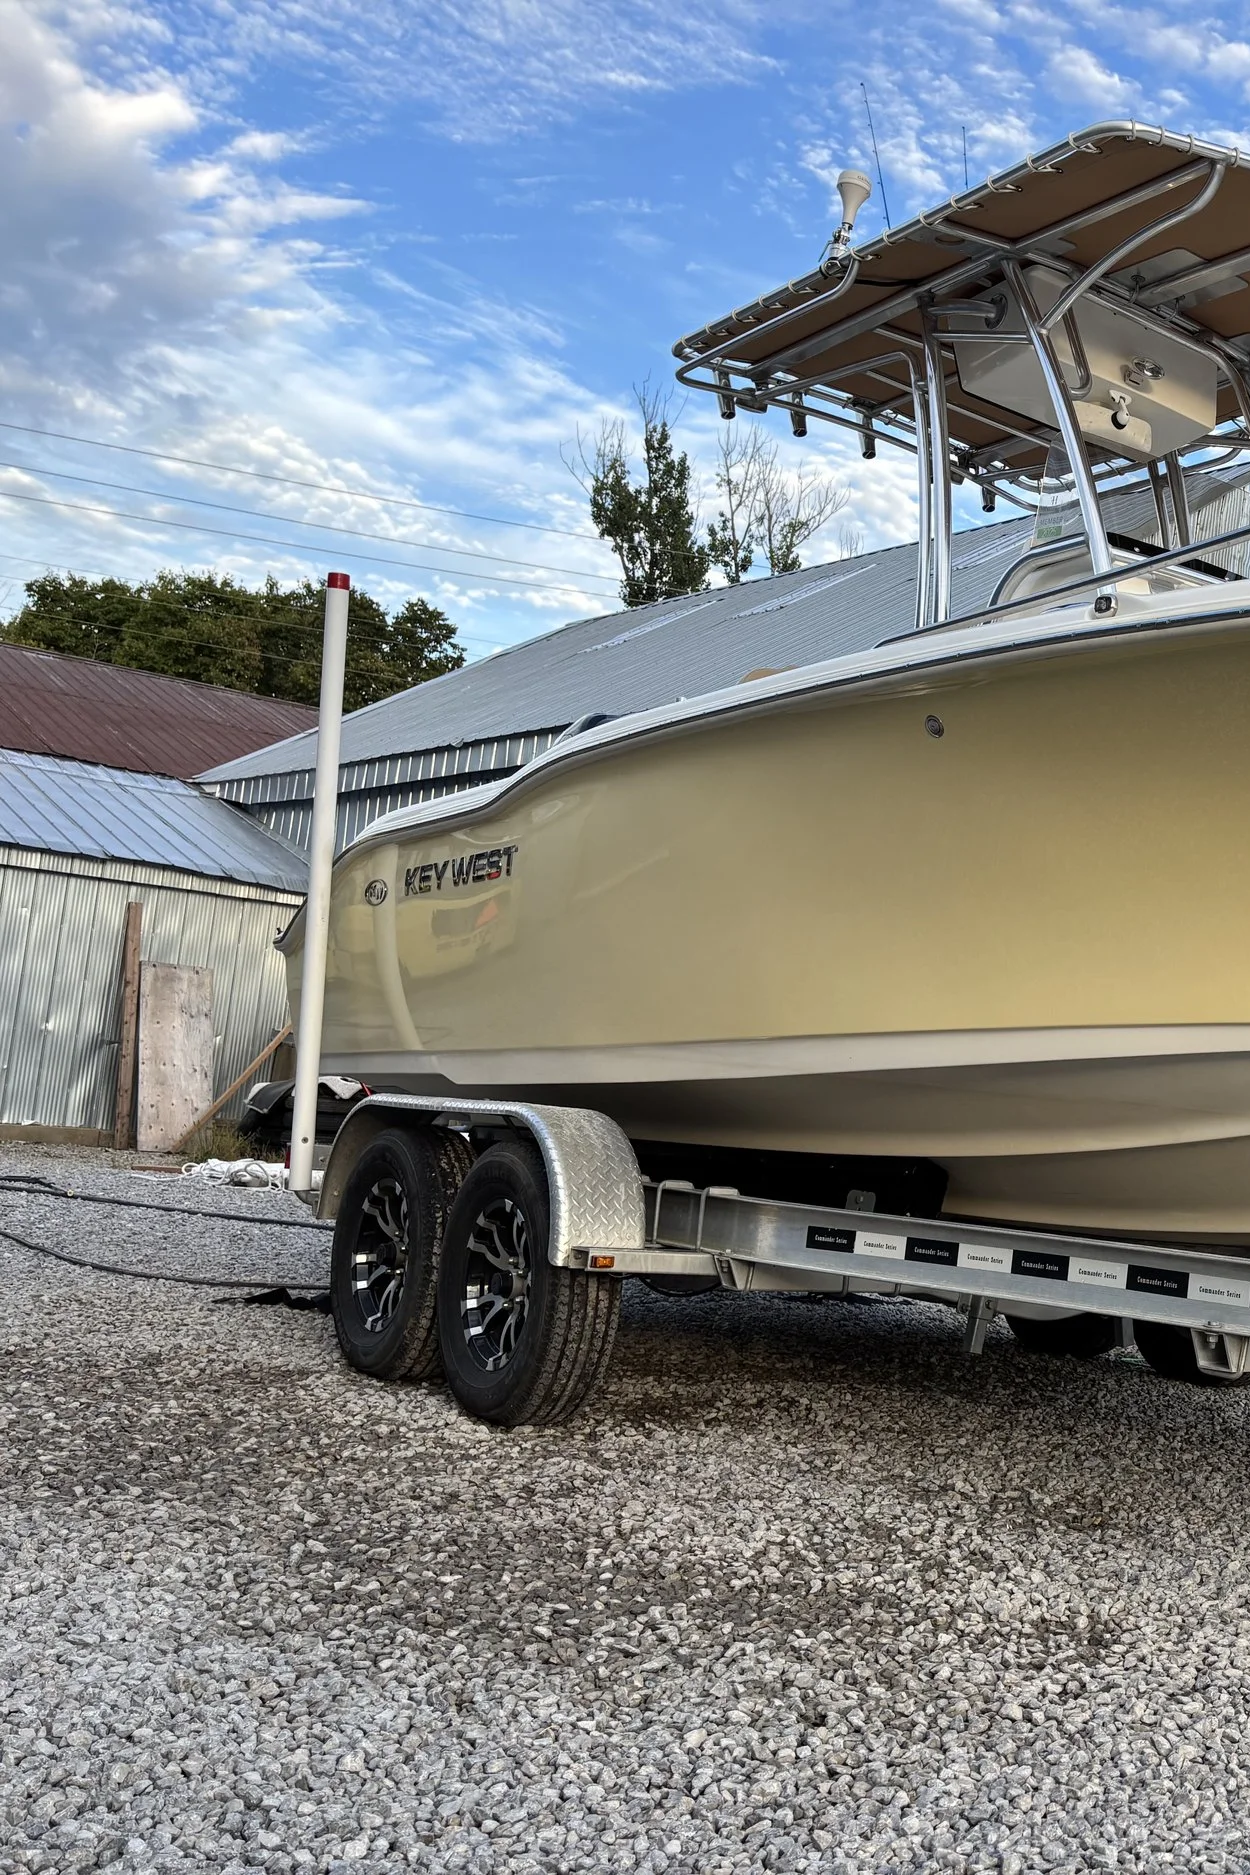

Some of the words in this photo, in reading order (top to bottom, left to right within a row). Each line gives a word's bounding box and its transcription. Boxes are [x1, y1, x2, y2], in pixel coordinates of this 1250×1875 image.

[404, 860, 450, 896] KEY
[452, 844, 518, 887] WEST
[864, 1241, 884, 1249] Commander
[914, 1246, 936, 1255] Commander
[967, 1254, 989, 1262] Commander
[990, 1256, 1003, 1264] Series
[1021, 1260, 1044, 1269] Commander
[1078, 1268, 1102, 1278] Commander
[1104, 1272, 1117, 1280] Series
[1137, 1276, 1162, 1286] Commander
[1163, 1280, 1178, 1288] Series
[1198, 1286, 1224, 1296] Commander
[1226, 1290, 1240, 1299] Series
